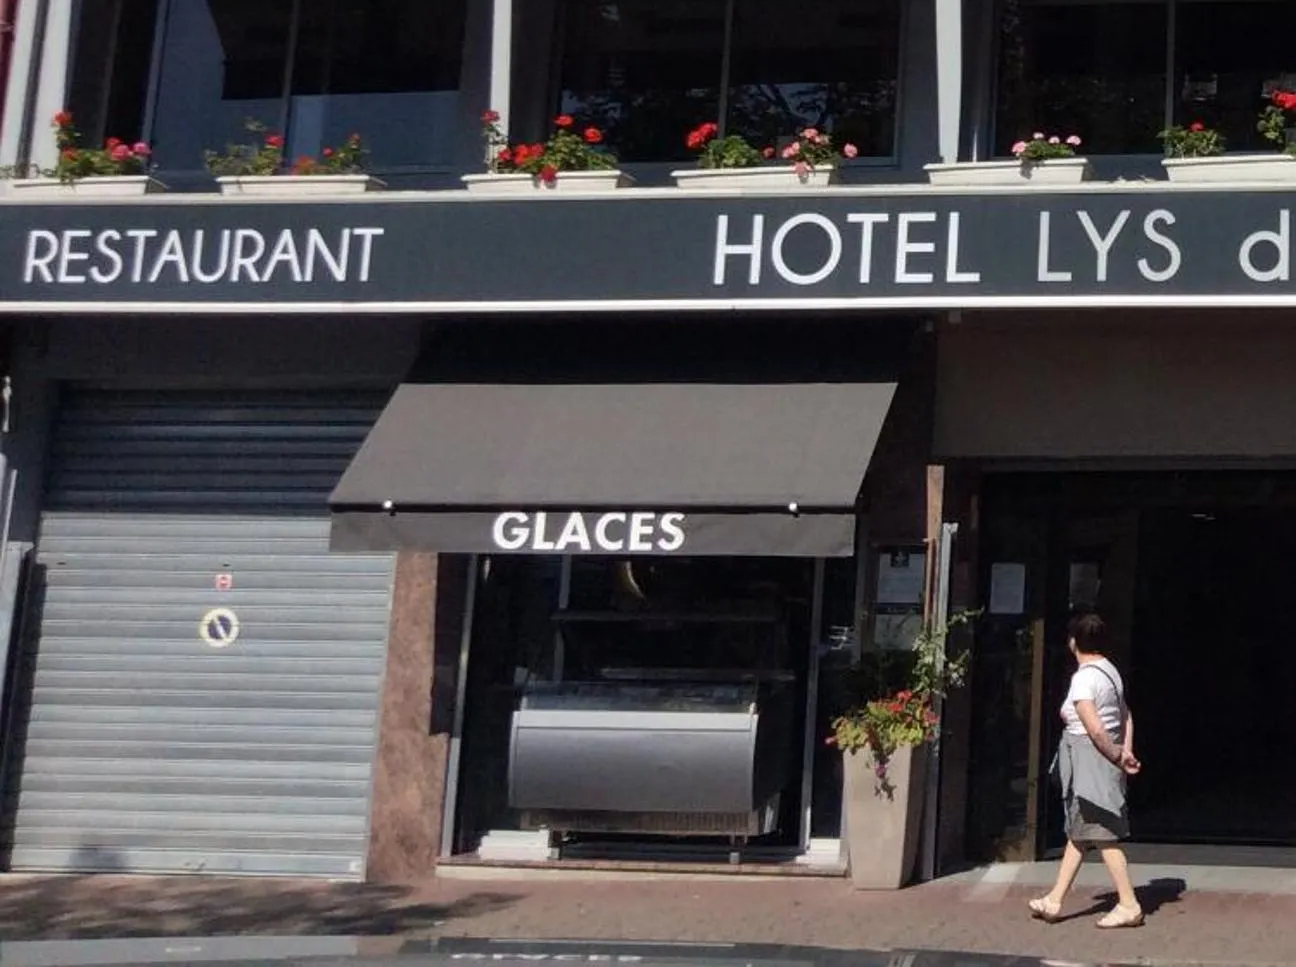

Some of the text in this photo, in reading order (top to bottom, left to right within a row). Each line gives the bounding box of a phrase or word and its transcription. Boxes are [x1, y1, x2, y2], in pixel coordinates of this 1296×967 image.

[24, 227, 384, 284] RESTAURANT
[713, 211, 981, 286] HOTEL
[1037, 208, 1181, 282] LYS
[492, 511, 685, 553] GLACES
